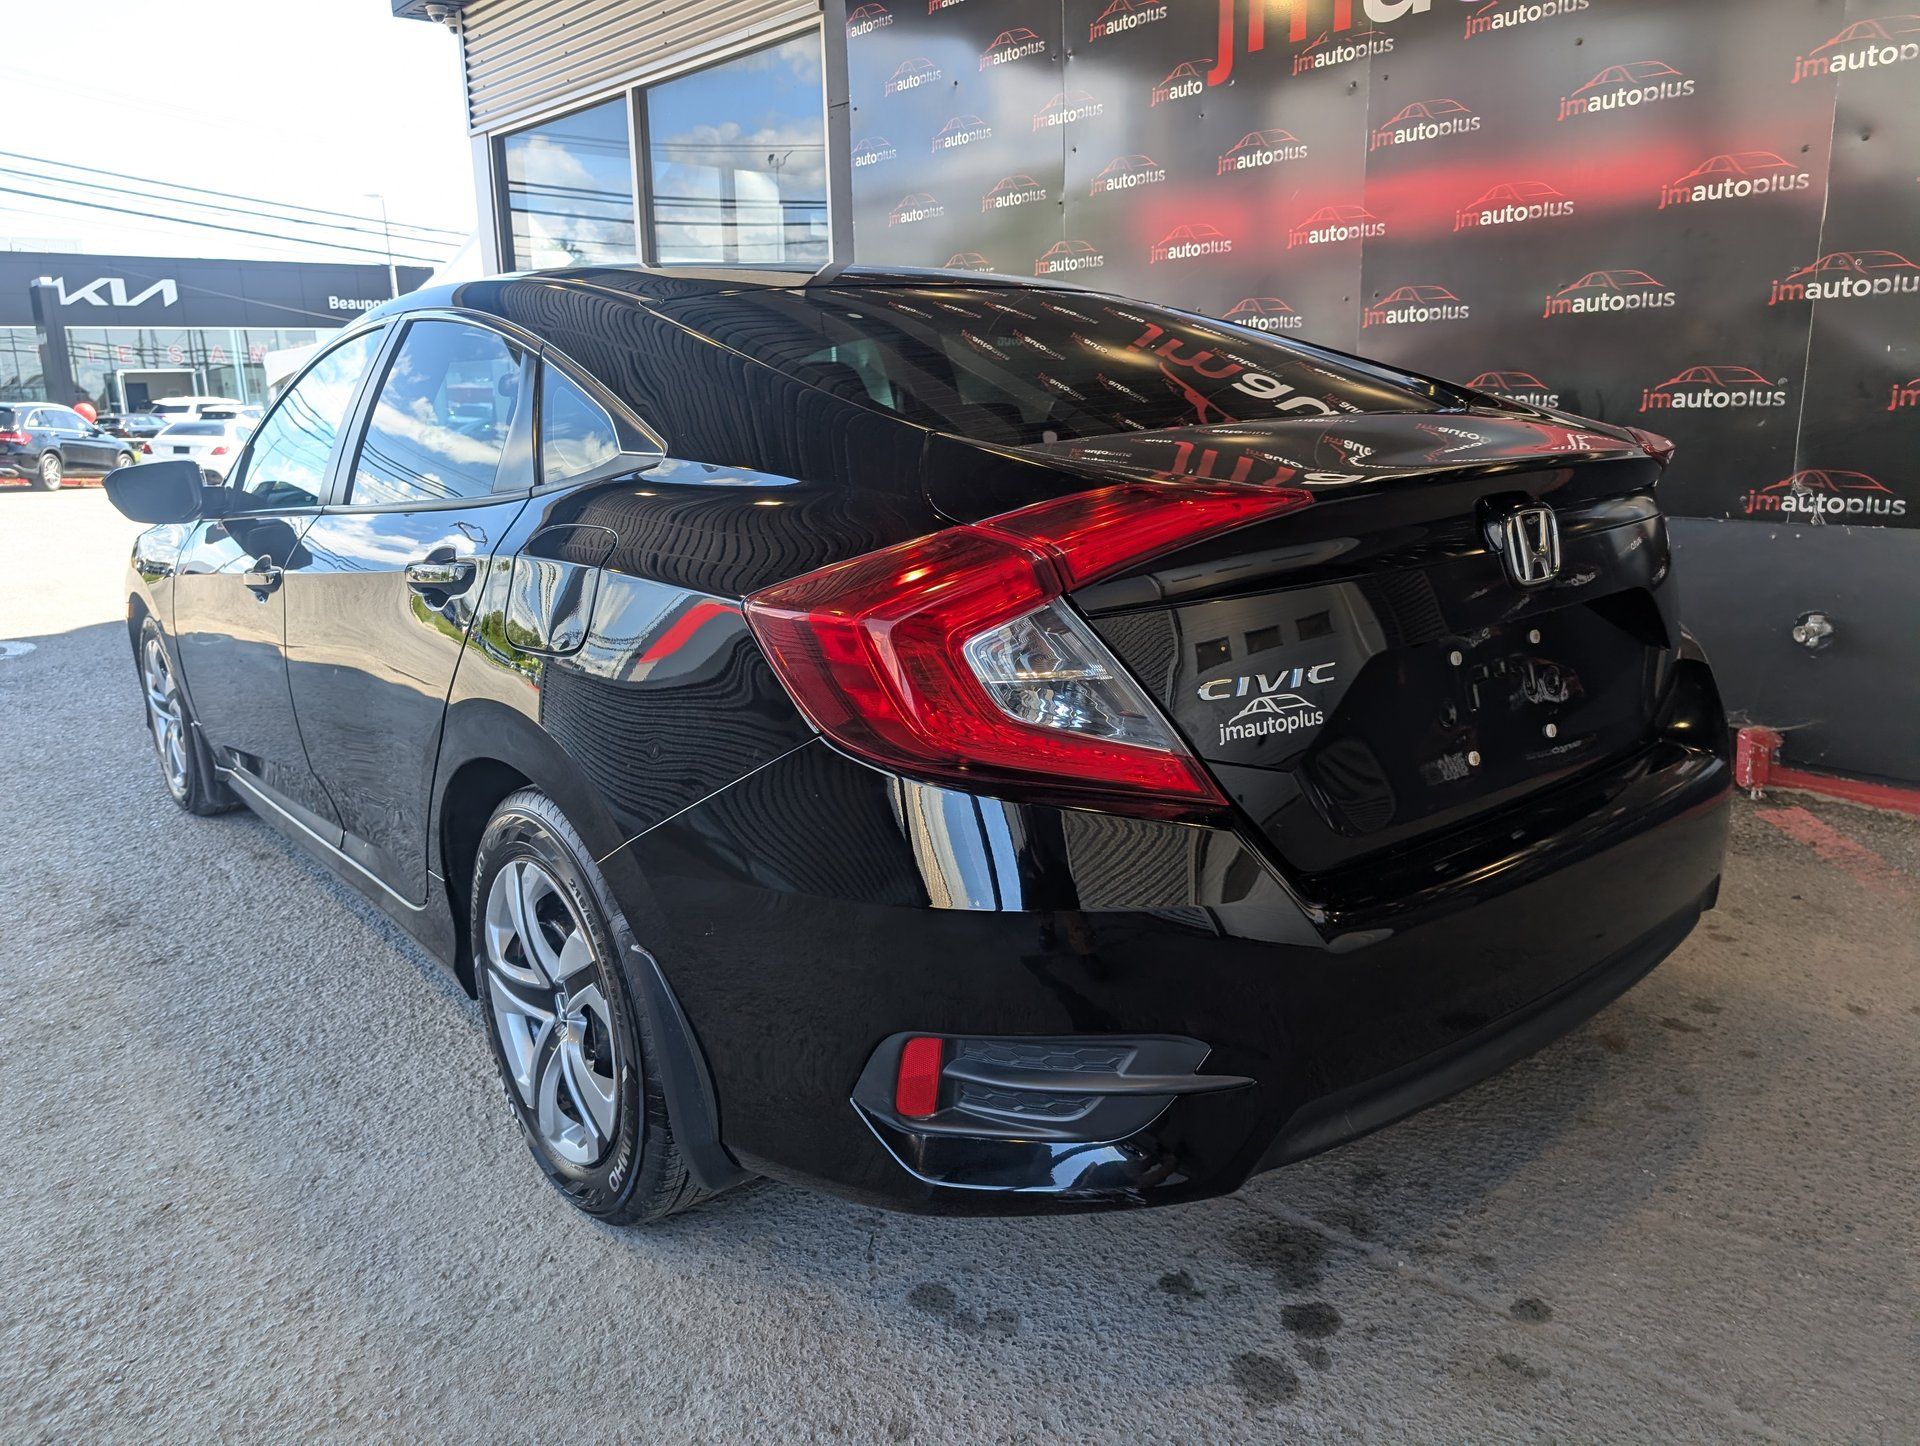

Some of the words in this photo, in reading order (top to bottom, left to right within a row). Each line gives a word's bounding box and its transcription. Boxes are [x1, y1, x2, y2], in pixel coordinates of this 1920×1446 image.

[846, 14, 893, 39] autoplus
[1089, 6, 1167, 43] jmautoplus
[1464, 0, 1590, 40] jmautoplus
[979, 40, 1045, 72] jmautoplus
[1292, 36, 1394, 76] jmautoplus
[885, 69, 942, 98] jmautoplus
[1151, 80, 1203, 107] jmauto
[1557, 78, 1695, 121] jmautoplus
[1033, 103, 1103, 132] jmautoplus
[931, 127, 992, 154] jmautoplus
[1370, 114, 1481, 151] jmautoplus
[852, 149, 897, 168] autoplus
[1217, 145, 1307, 176] jmautoplus
[1089, 169, 1166, 196] jmautoplus
[1658, 172, 1810, 210] jmautoplus
[981, 189, 1047, 213] jmautoplus
[1453, 199, 1574, 231] jmautoplus
[888, 205, 944, 228] jmautoplus
[1287, 222, 1385, 249] jmautoplus
[1150, 239, 1232, 264] jmautoplus
[1034, 255, 1104, 277] jmautoplus
[51, 276, 178, 307] KIA
[1543, 290, 1676, 318] jmautoplus
[1362, 304, 1469, 329] jmautoplus
[1639, 388, 1786, 413] jmautoplus
[1745, 489, 1906, 515] jmautoplus
[1197, 662, 1336, 701] CIVIC
[1219, 710, 1324, 746] jmautoplus
